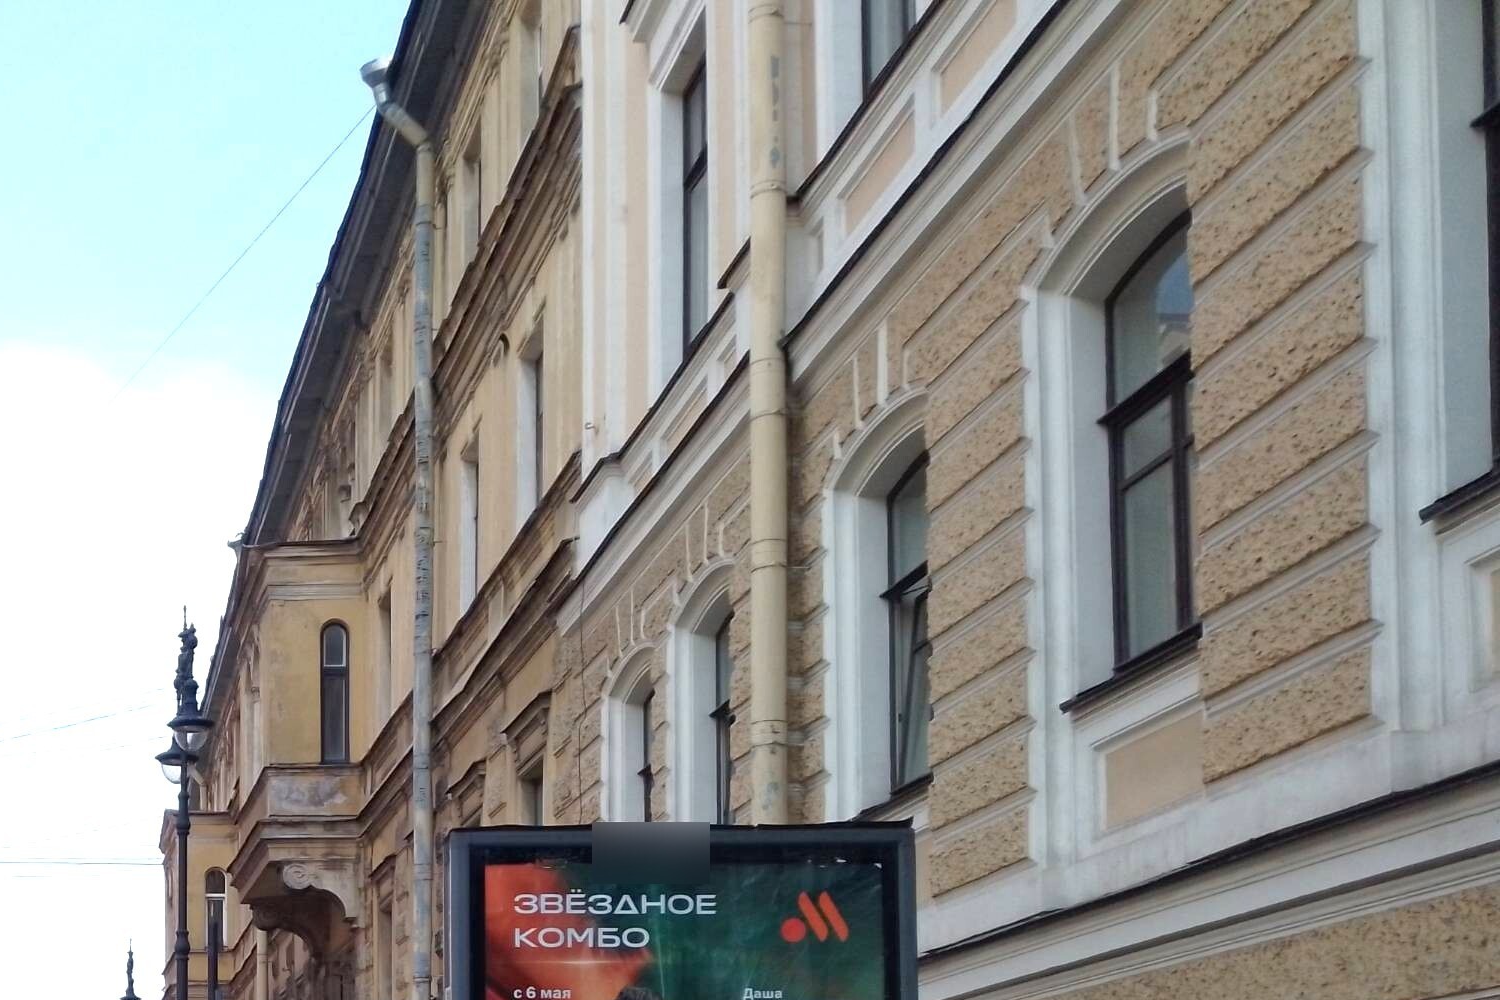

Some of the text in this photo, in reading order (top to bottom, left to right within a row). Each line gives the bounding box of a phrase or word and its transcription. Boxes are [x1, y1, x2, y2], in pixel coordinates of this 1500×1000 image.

[514, 889, 717, 915] ЗВЁЗДНОЕ
[514, 927, 650, 949] КОМБО
[513, 986, 572, 999] с 6 мая
[743, 987, 783, 1000] Даша
